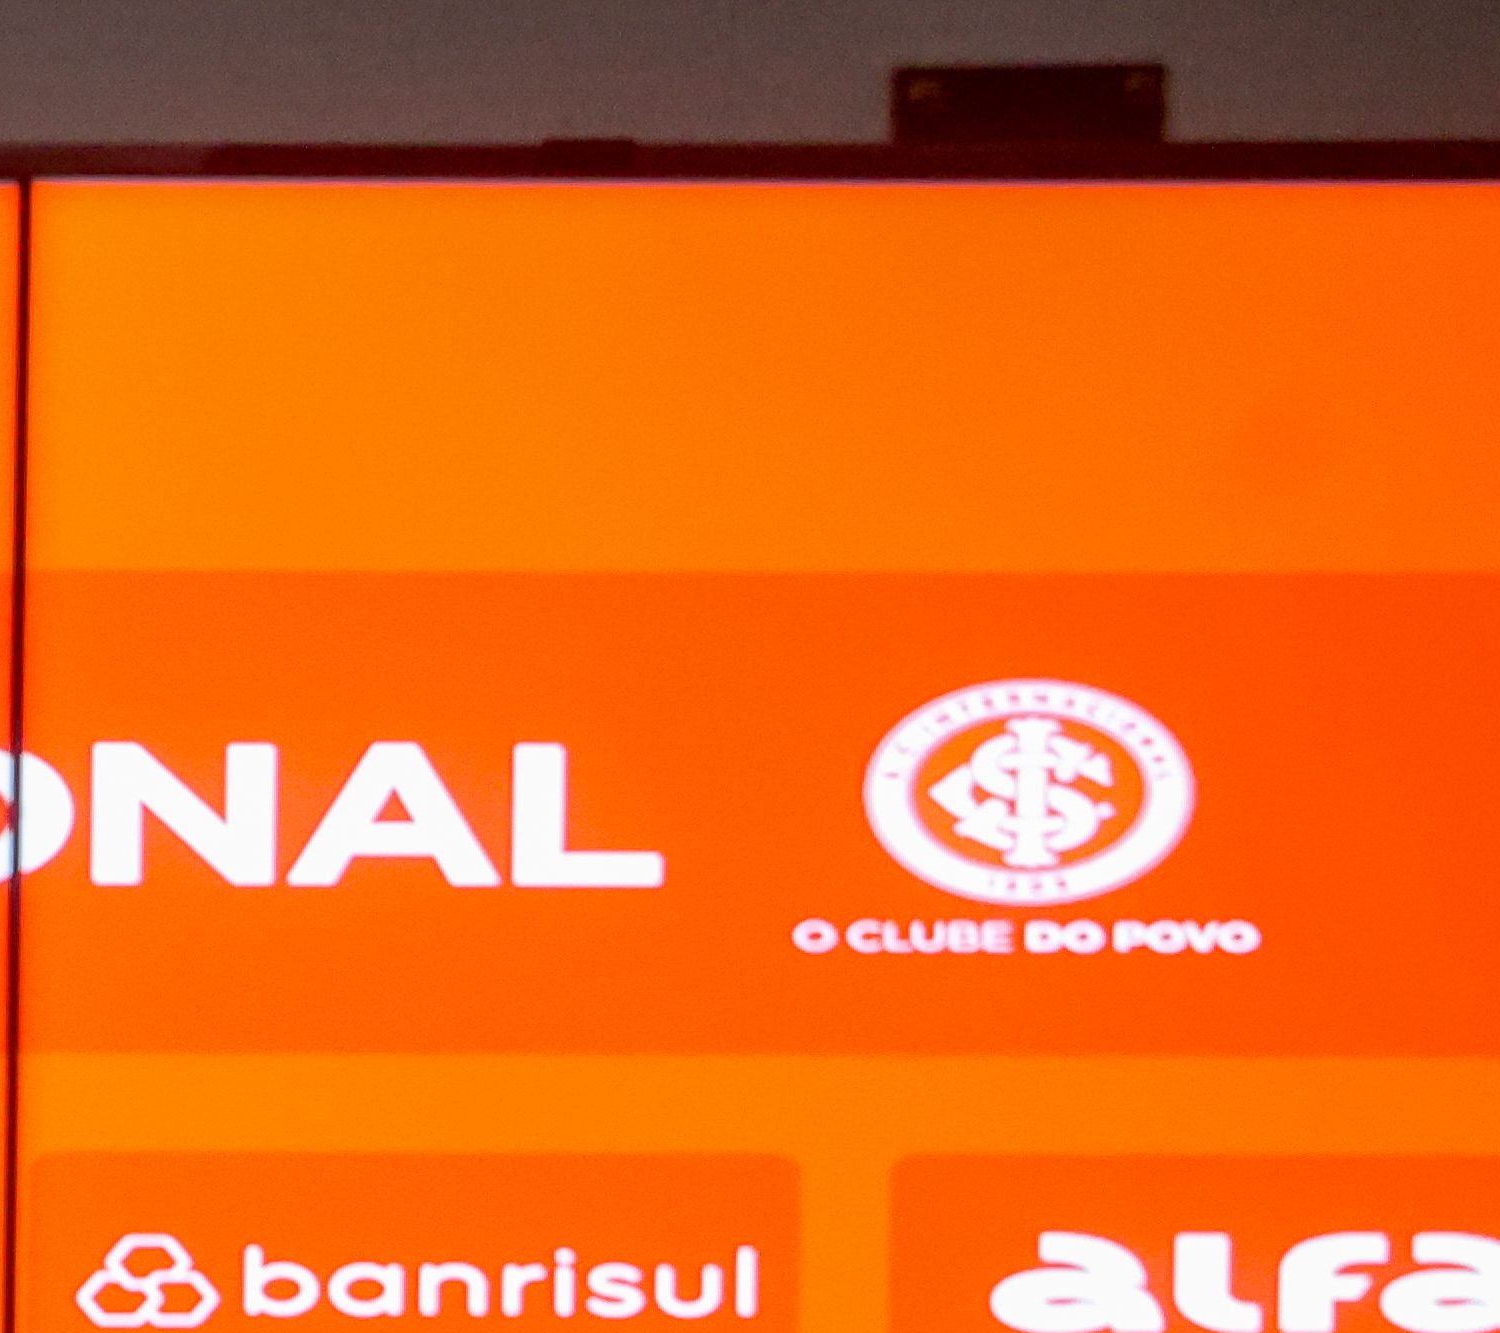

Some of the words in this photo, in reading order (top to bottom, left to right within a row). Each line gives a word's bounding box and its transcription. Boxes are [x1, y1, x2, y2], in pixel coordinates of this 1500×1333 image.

[793, 919, 838, 953] O
[846, 919, 1013, 953] CLUBE
[1024, 920, 1107, 954] DO
[1113, 920, 1261, 953] POVO
[244, 1244, 758, 1318] banrisul
